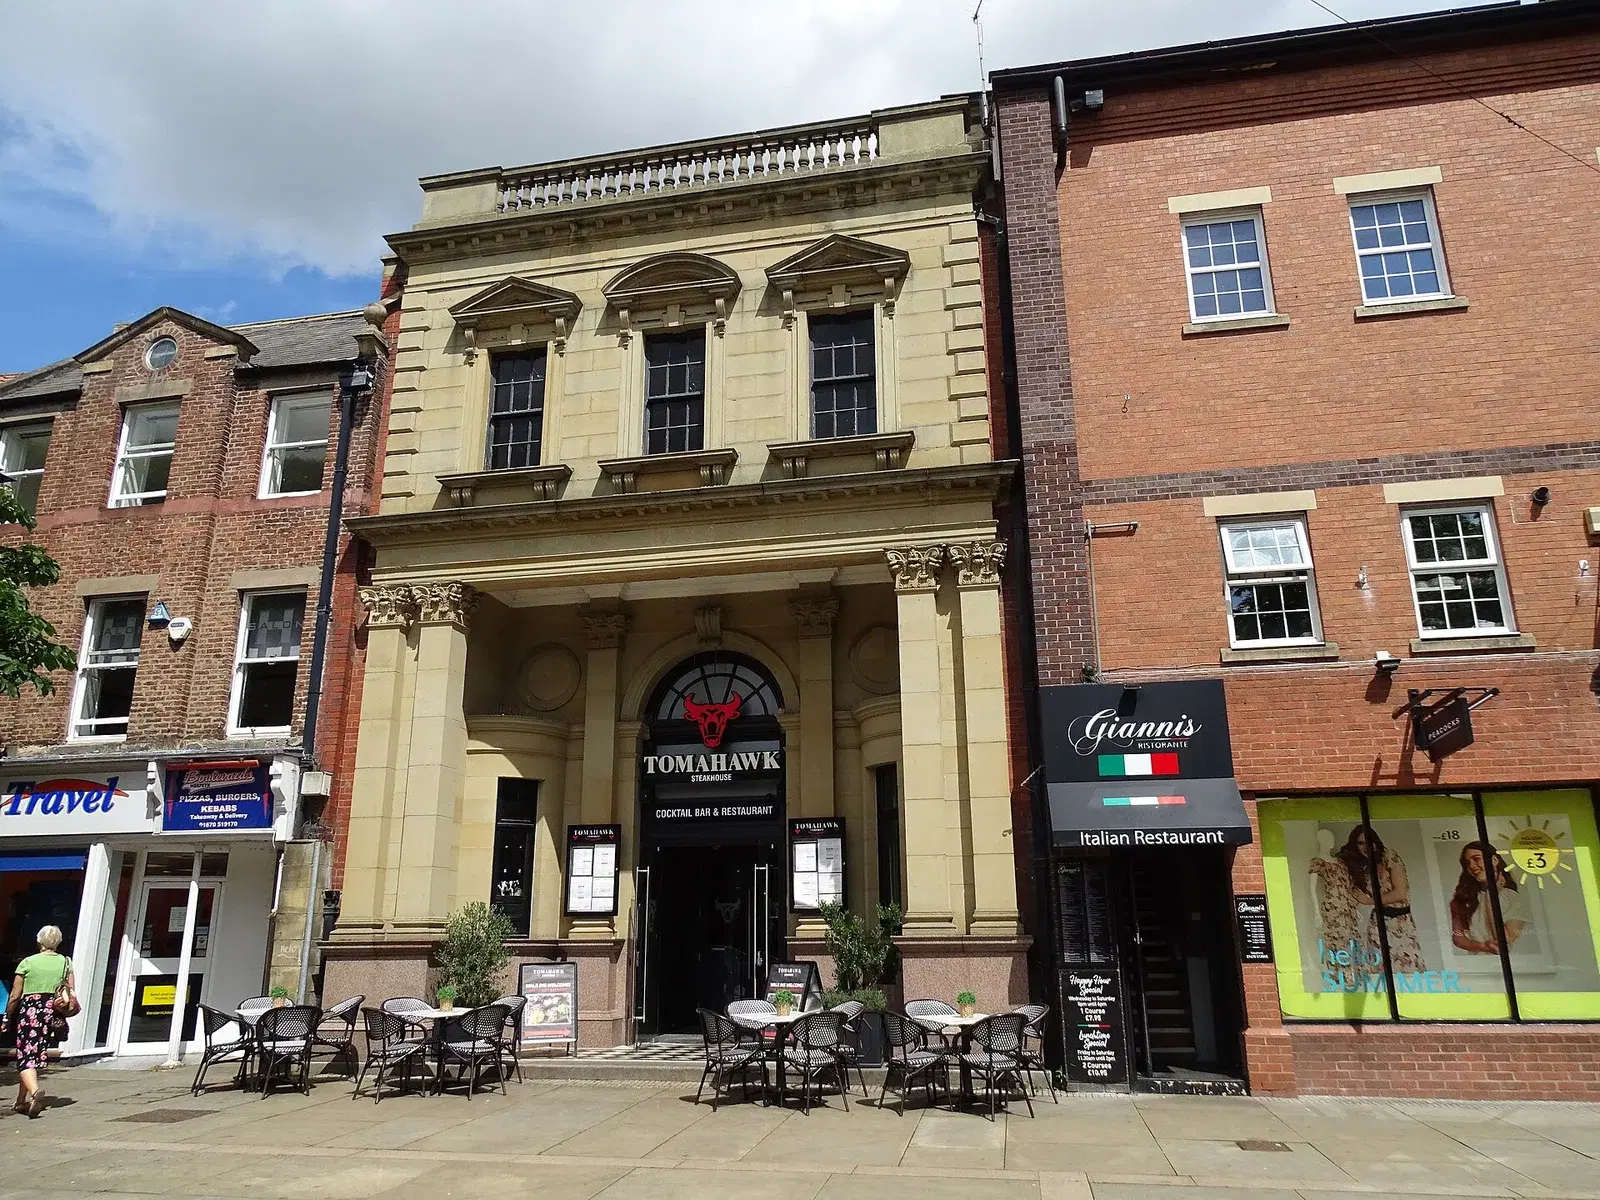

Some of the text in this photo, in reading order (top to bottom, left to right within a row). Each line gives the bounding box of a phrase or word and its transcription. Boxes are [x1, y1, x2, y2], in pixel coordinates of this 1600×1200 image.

[1067, 708, 1203, 756] Giannis
[1427, 717, 1461, 741] PEACOCKS
[1137, 740, 1189, 749] RISTORANTE
[643, 750, 781, 774] TOMAHAWK
[183, 767, 255, 785] Boulevards
[690, 773, 732, 783] STEAKHOUSE
[4, 776, 120, 816] Travel
[179, 792, 261, 803] PIZZAS, BURGERS,
[200, 804, 238, 813] KEBABS
[655, 805, 774, 819] COCKTAIL BAR & RESTAURANT
[224, 812, 248, 820] Delivery
[573, 828, 615, 836] TOMAHAWK
[795, 821, 839, 830] TOMAHAWK
[1080, 829, 1225, 846] Italian Restaurant
[1441, 829, 1460, 841] £18
[1526, 853, 1547, 869] £3
[1317, 938, 1383, 968] hello
[1069, 974, 1112, 988] Happy Hour
[1320, 969, 1472, 994] SUMMER.
[1079, 984, 1104, 997] Special
[1078, 1029, 1111, 1041] Lunchtime
[1083, 1038, 1108, 1051] Special
[1087, 1069, 1108, 1077] £10.95
